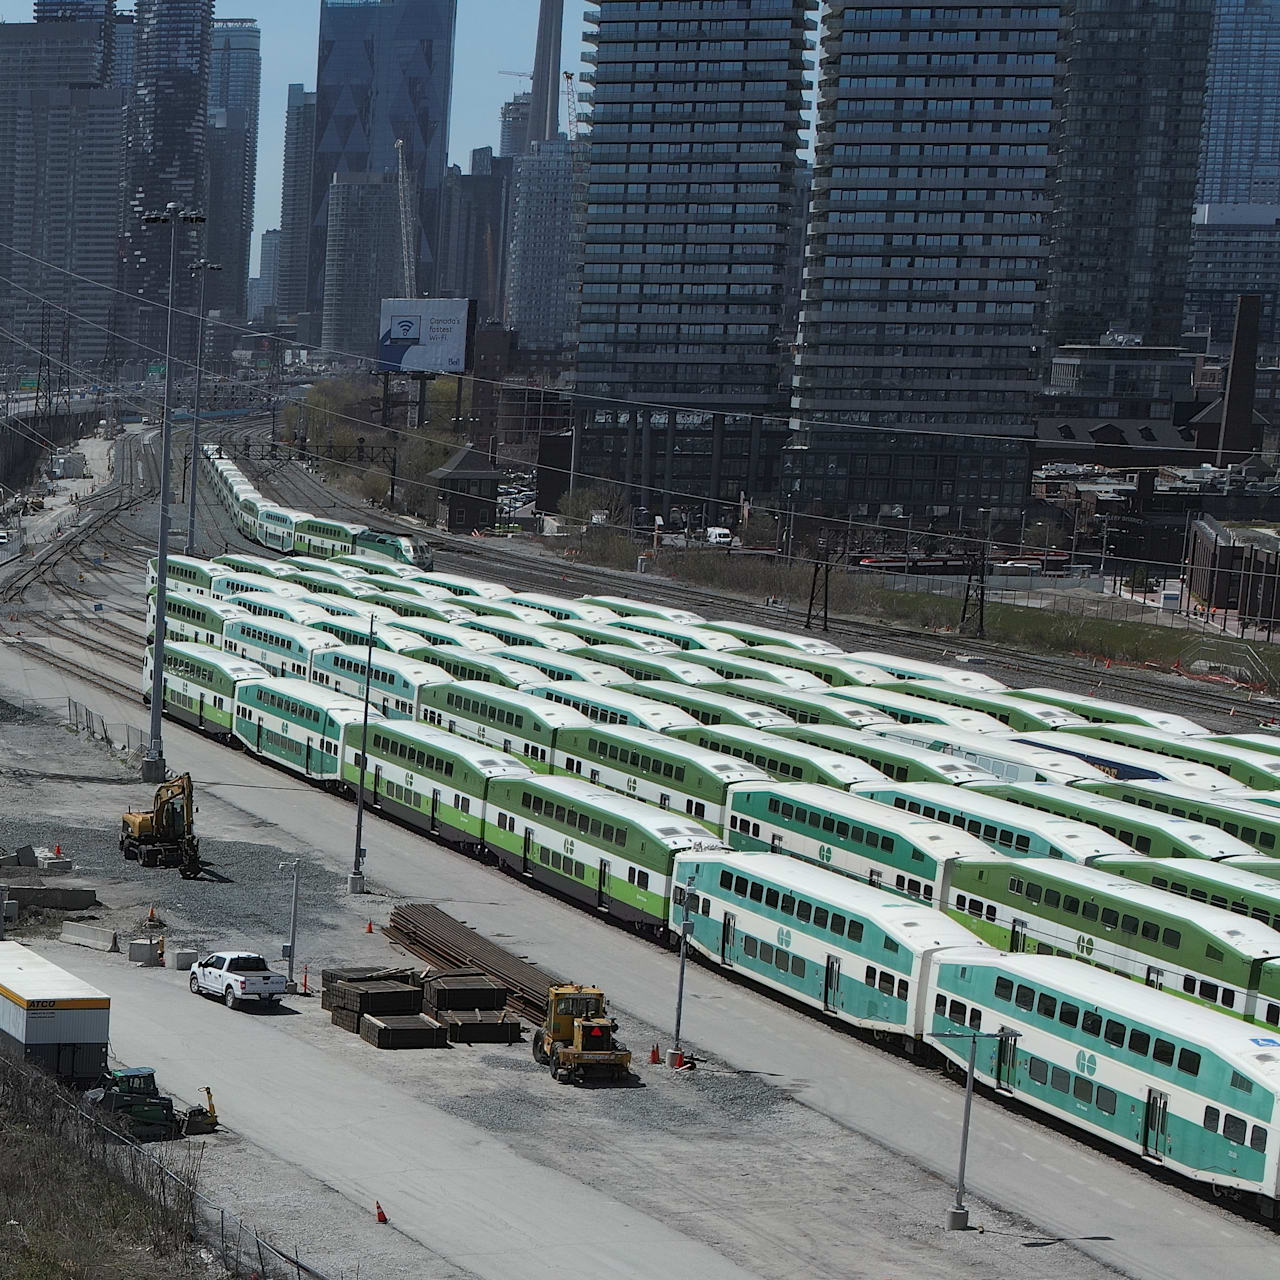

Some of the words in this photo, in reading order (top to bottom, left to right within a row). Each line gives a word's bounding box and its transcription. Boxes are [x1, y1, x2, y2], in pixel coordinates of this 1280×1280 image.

[429, 317, 460, 325] Canada's
[448, 358, 460, 366] Bell
[28, 1000, 56, 1008] ATCO
